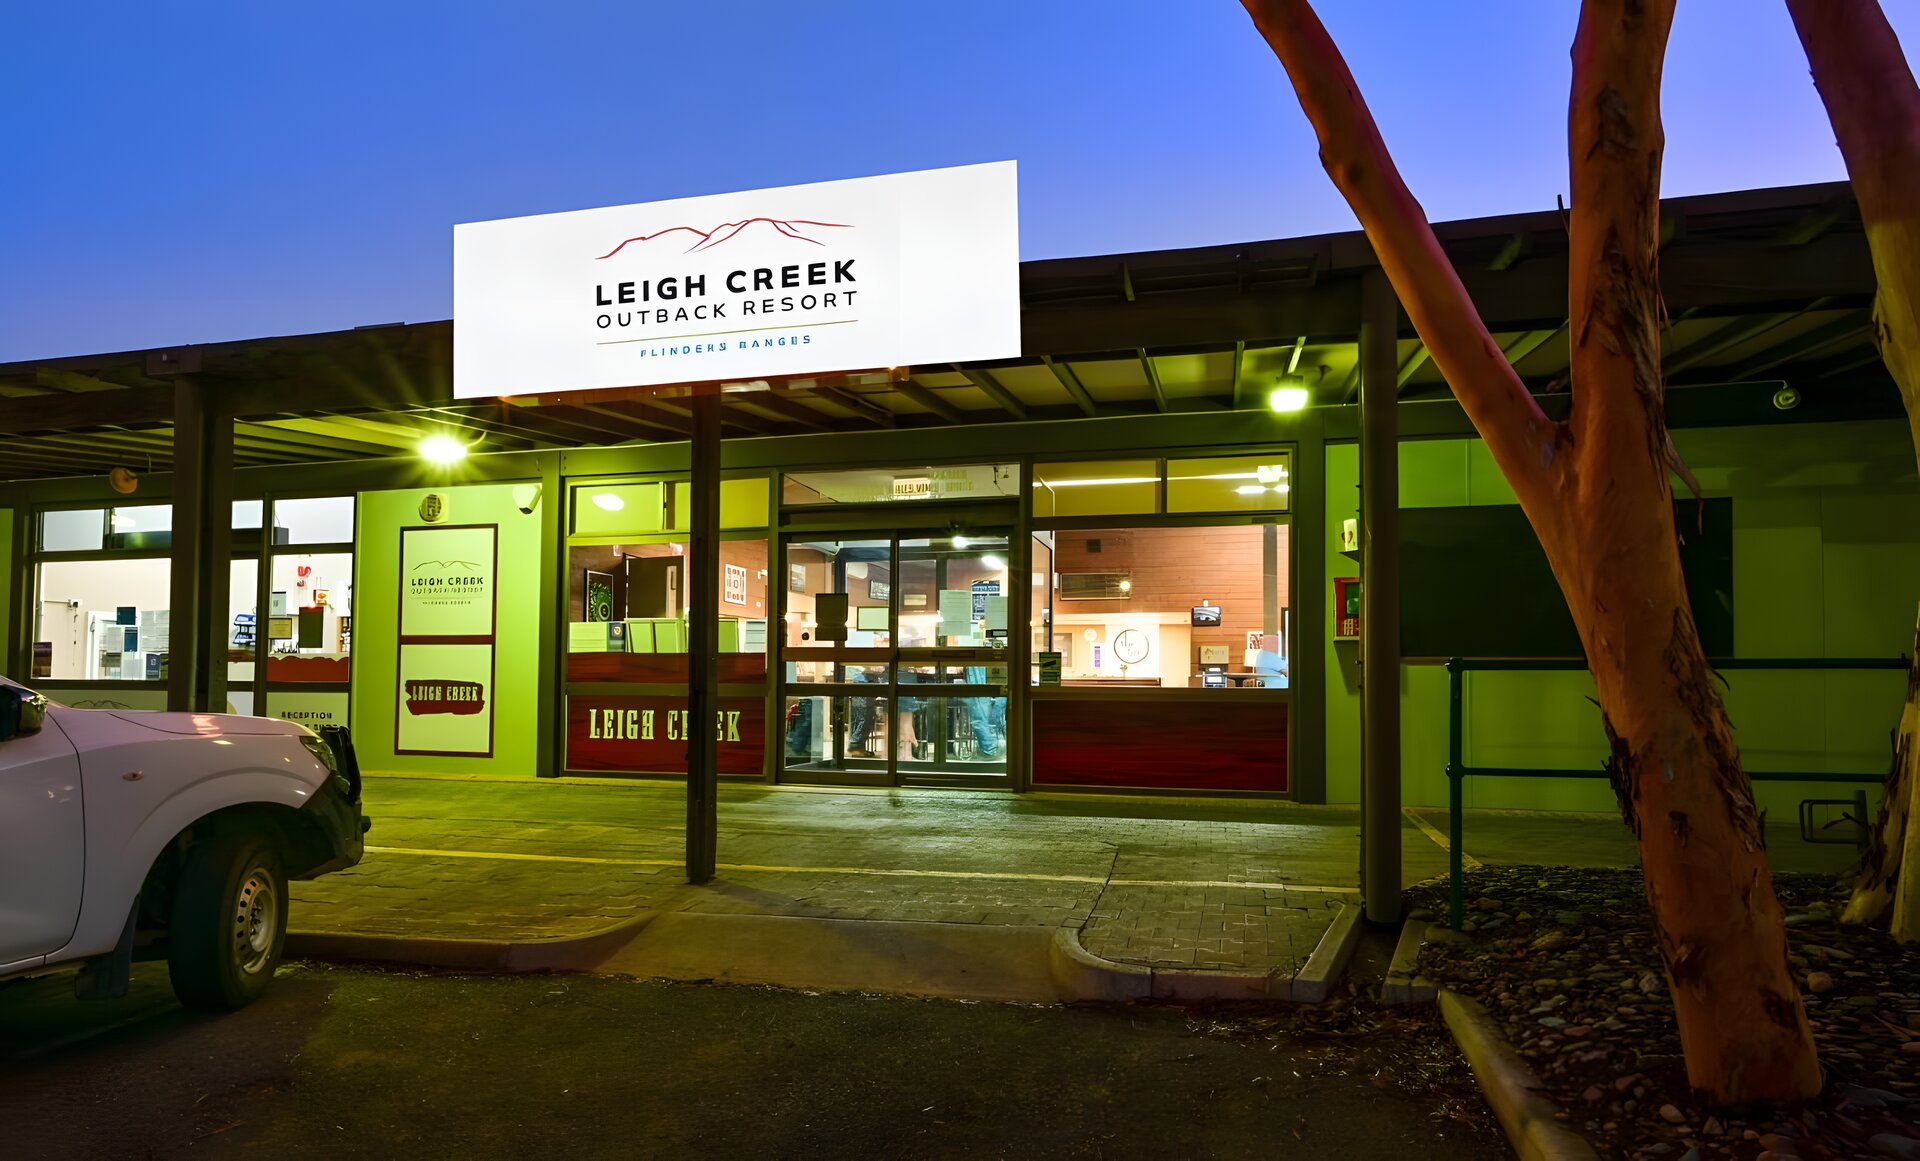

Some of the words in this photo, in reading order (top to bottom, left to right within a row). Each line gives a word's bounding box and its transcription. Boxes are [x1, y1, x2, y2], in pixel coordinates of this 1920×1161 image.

[596, 274, 706, 307] LEIGH
[725, 259, 857, 294] CREEK
[596, 302, 727, 329] OUTBACK
[742, 290, 858, 316] RESORT
[640, 342, 728, 358] FLINDERS
[738, 334, 813, 350] RANGES
[412, 685, 442, 701] LEIGH
[446, 686, 478, 701] CREEK
[589, 708, 655, 740] LEIGH
[667, 710, 741, 742] CEK
